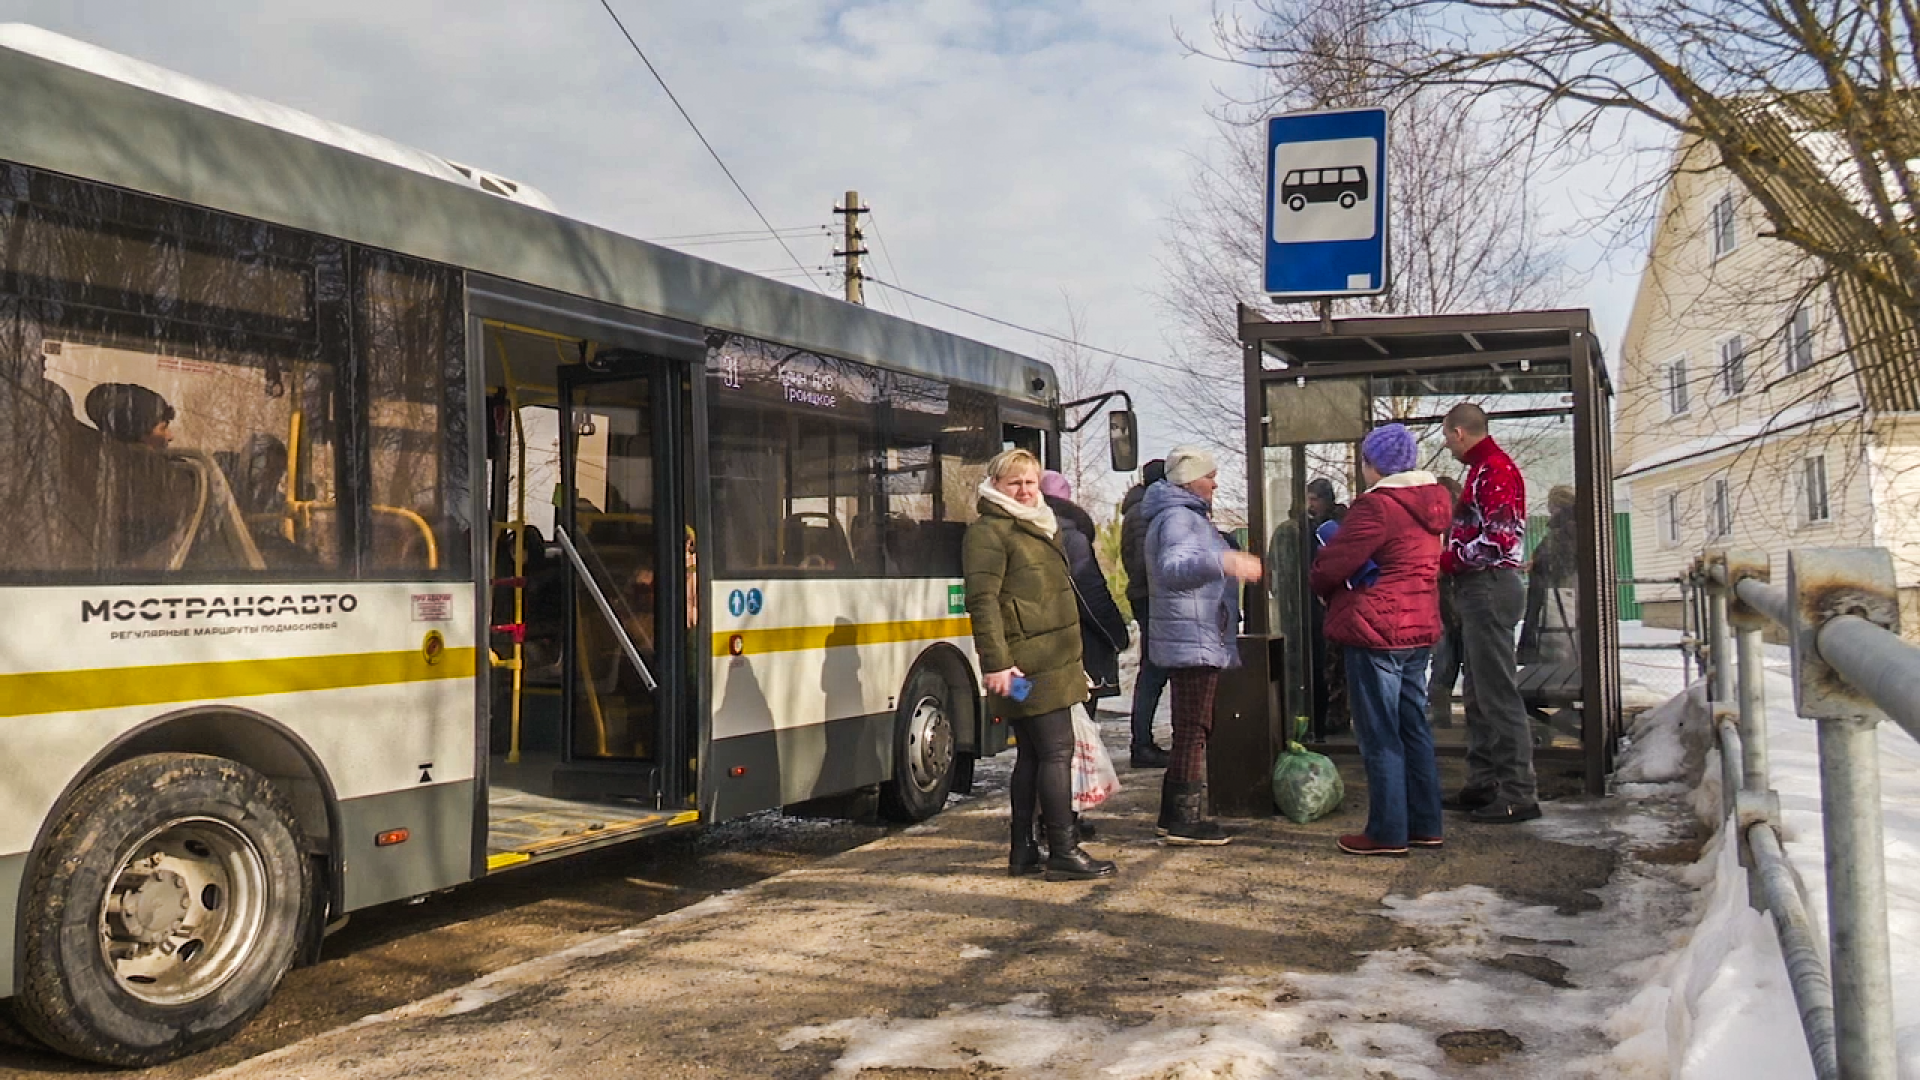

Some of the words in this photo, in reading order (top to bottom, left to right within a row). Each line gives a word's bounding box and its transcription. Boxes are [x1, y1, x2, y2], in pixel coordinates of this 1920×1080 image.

[81, 593, 358, 622] МОСТРАНСАВТО
[110, 627, 191, 640] РЕГУЛЯРНЫЕ
[193, 624, 260, 637] МАРШРУТЫ
[260, 620, 338, 634] ПОДМОСКОВЬЯ
